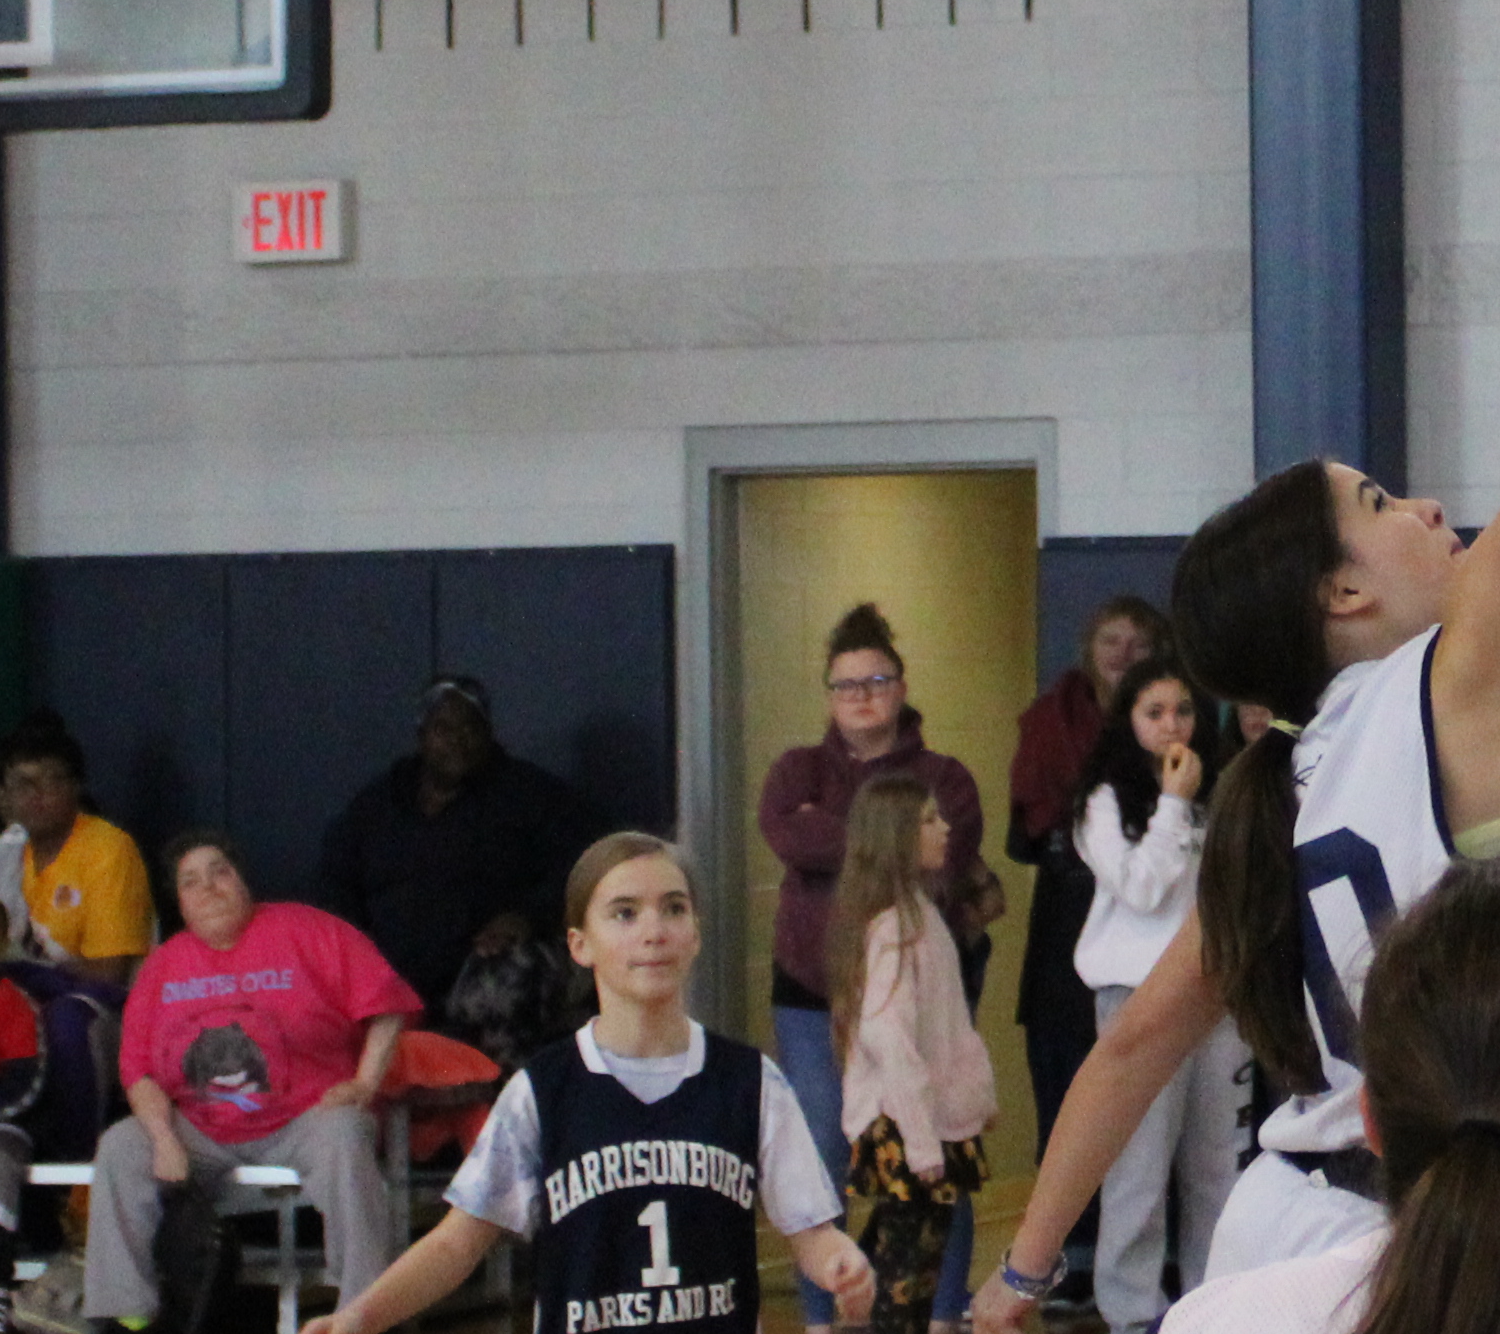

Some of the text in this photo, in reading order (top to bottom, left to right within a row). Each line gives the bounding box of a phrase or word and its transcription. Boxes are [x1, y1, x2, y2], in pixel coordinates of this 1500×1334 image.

[252, 190, 326, 252] EXIT
[545, 1140, 755, 1224] HARRISONBURG
[637, 1200, 680, 1287] 1
[566, 1292, 652, 1334] PARKS
[656, 1285, 706, 1324] AND
